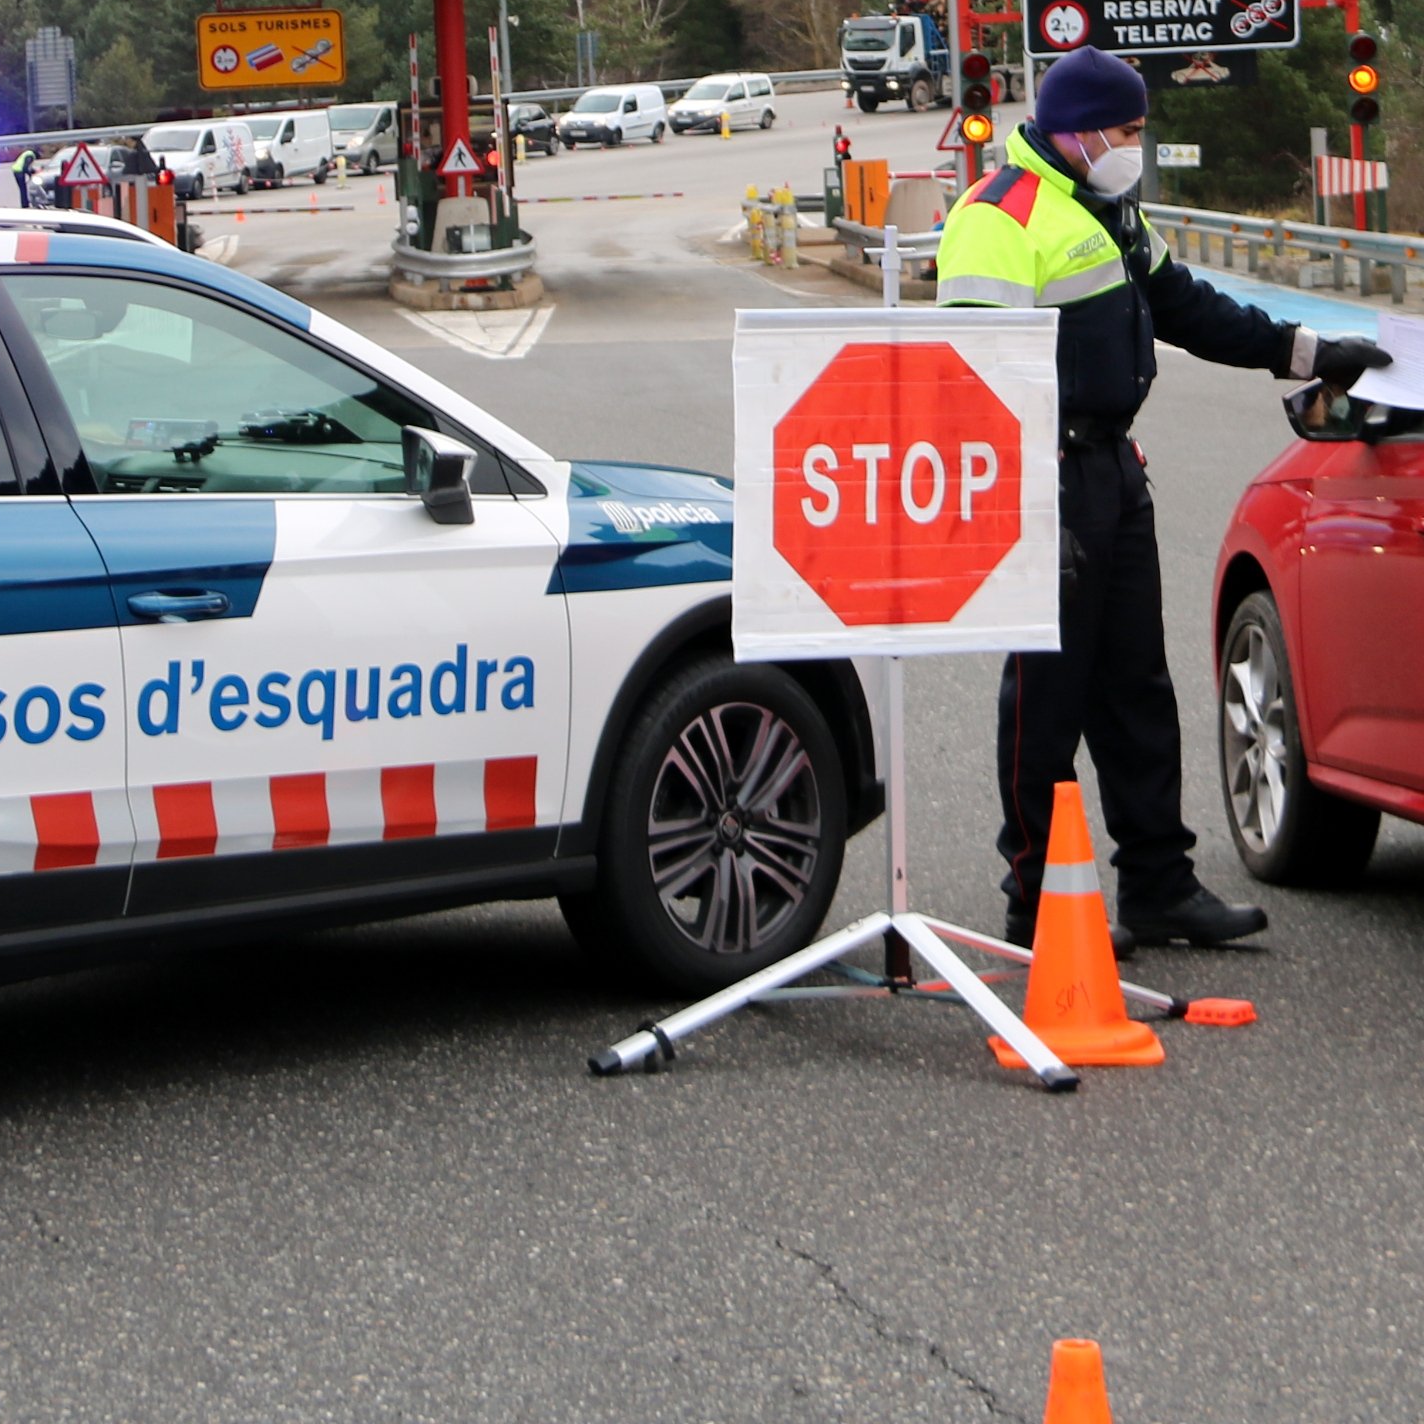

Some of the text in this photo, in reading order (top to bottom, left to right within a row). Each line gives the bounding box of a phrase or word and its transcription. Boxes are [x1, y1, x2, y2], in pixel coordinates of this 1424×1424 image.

[208, 18, 331, 34] SOLS TURISMES
[1113, 21, 1213, 44] TELETAC
[800, 440, 998, 528] STOP
[136, 643, 536, 741] d'esquadra
